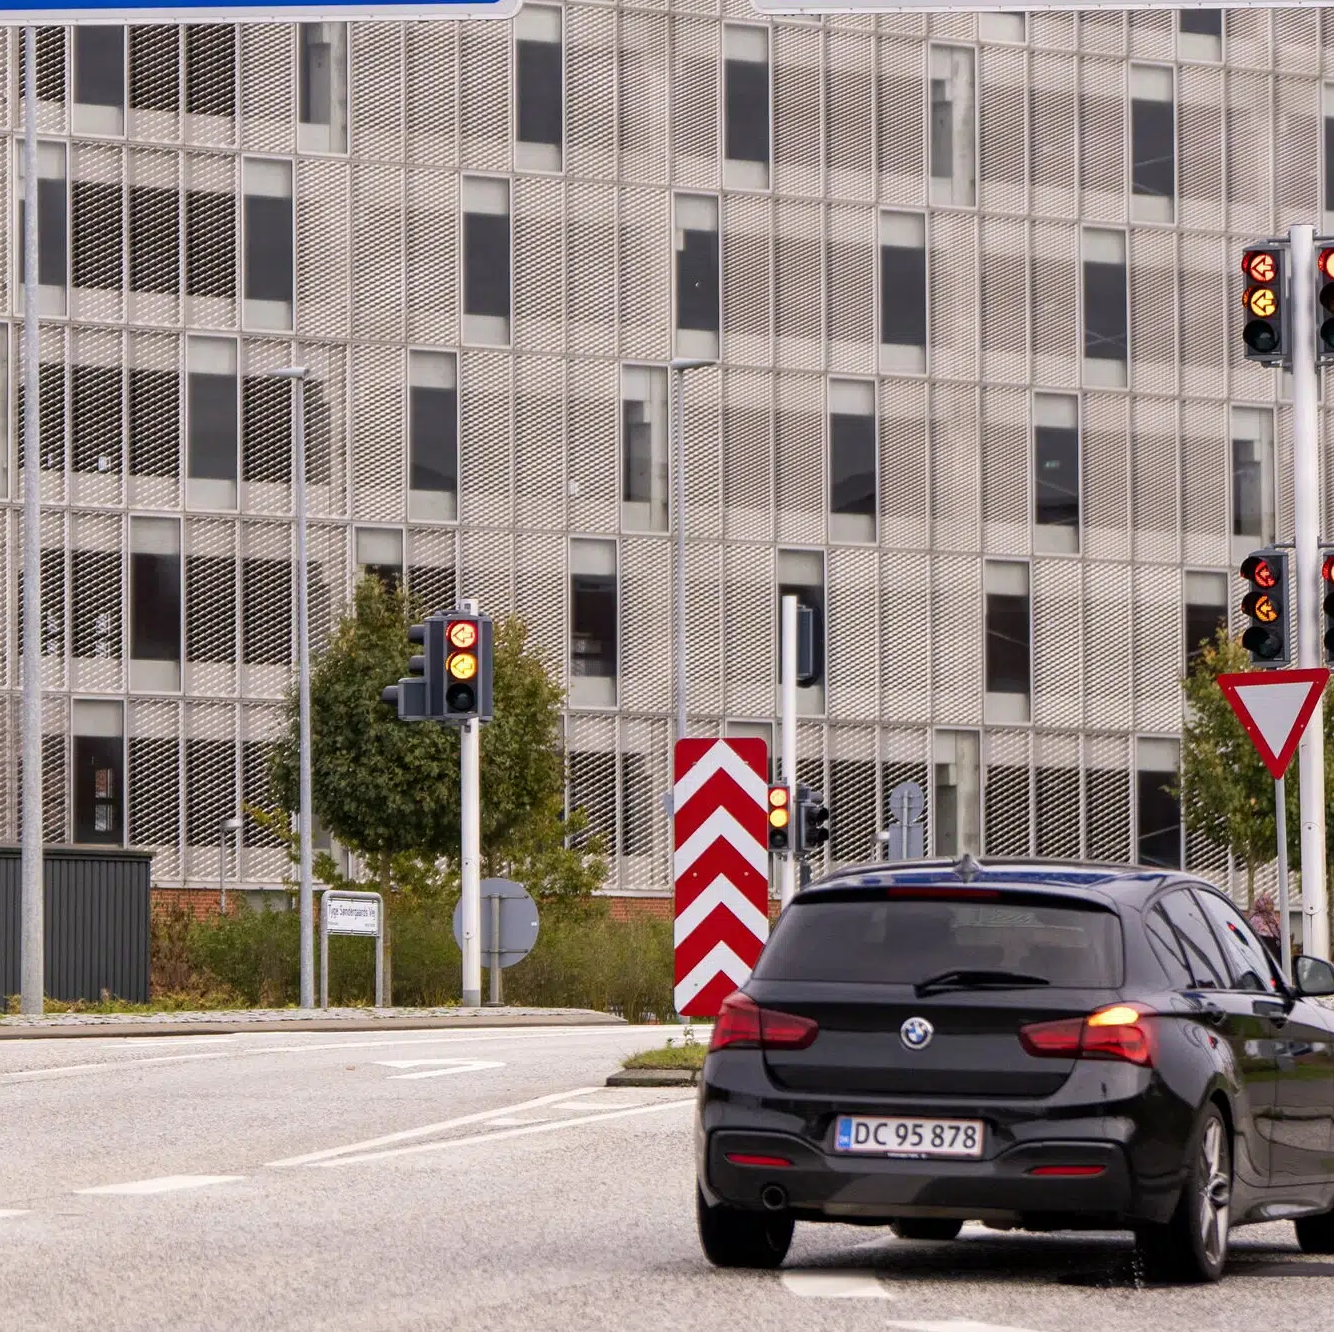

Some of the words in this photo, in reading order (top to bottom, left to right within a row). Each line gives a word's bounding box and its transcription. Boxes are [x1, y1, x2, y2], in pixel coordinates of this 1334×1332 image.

[854, 1122, 888, 1146] DC
[895, 1123, 923, 1147] 95
[930, 1124, 976, 1149] 878
